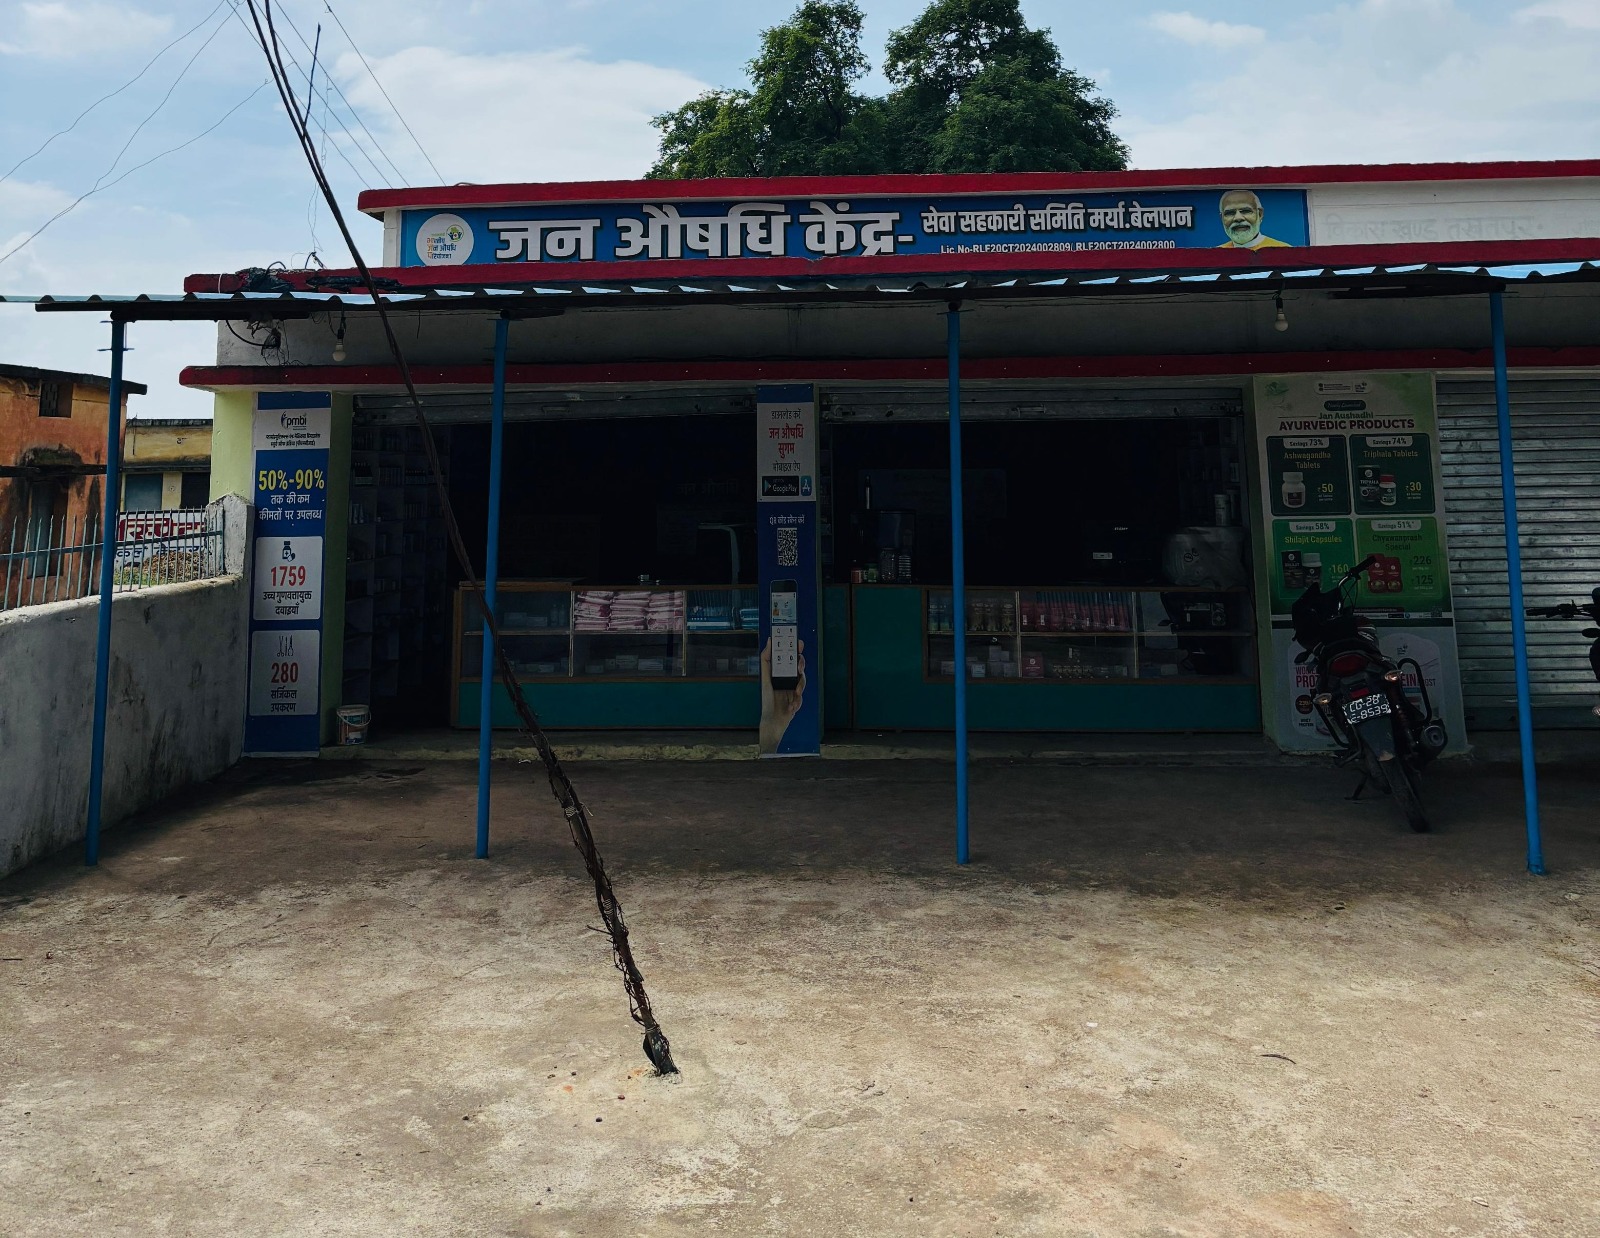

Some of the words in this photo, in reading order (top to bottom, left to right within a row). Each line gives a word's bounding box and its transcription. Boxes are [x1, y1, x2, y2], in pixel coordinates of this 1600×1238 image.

[921, 205, 957, 233] सेवा
[958, 203, 1026, 232] सहकारी
[1027, 202, 1086, 231] समिति
[489, 218, 601, 261] जन
[615, 203, 791, 260] औषधि
[287, 415, 307, 428] pmbi
[1318, 412, 1334, 421] Jan
[1335, 411, 1374, 421] Aushadhi
[769, 427, 780, 439] जन
[781, 423, 805, 439] औषधि
[1279, 420, 1347, 432] AYURVEDIC
[1350, 419, 1415, 431] PRODUCTS
[1309, 438, 1324, 446] 73%
[1391, 437, 1407, 445] 74%
[778, 442, 795, 459] सुगम
[1295, 461, 1321, 470] Tablets
[259, 469, 325, 491] 50%-90%
[271, 495, 285, 505] तक
[286, 492, 297, 504] की
[297, 494, 310, 504] कम
[259, 508, 283, 521] कीमतों
[284, 510, 295, 520] पर
[296, 510, 322, 520] उपलब्ध
[1315, 522, 1330, 531] 58%
[271, 565, 306, 587] 1759
[271, 662, 299, 684] 280
[270, 685, 298, 699] सर्जिकल
[270, 702, 297, 713] उपकरण
